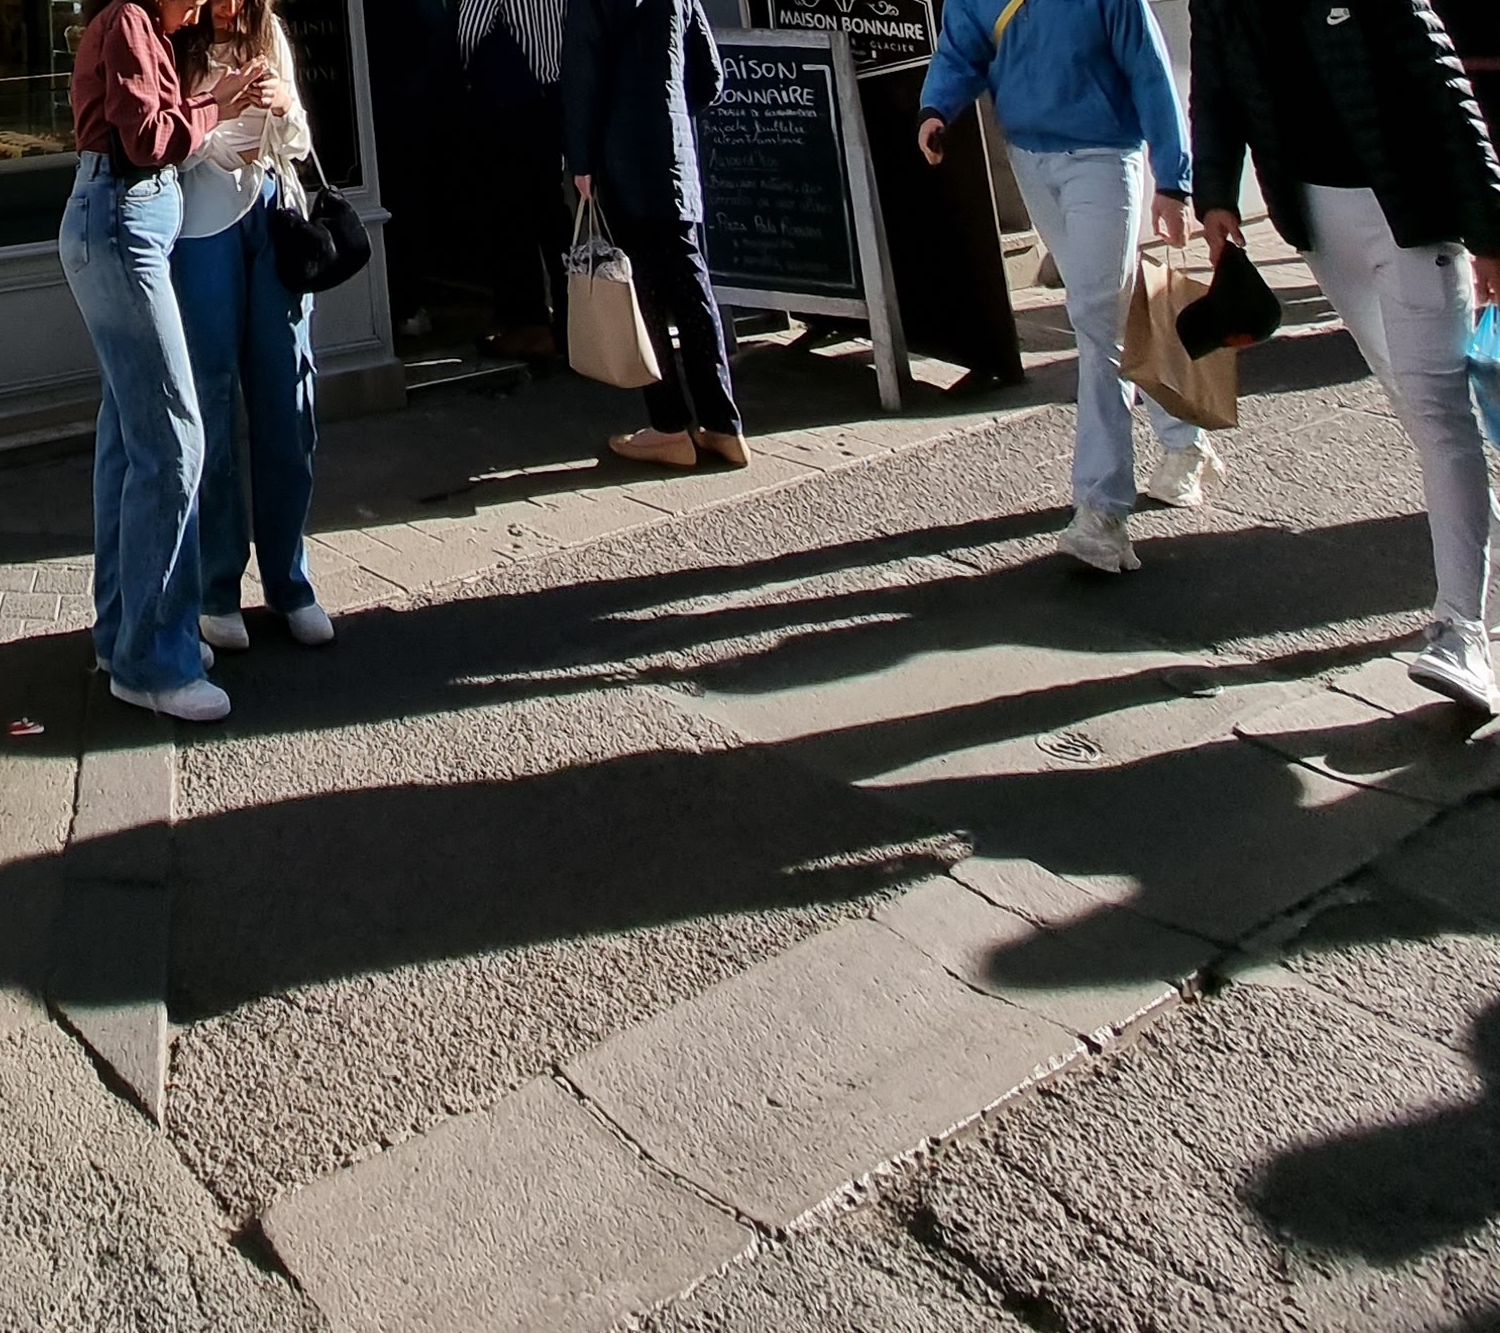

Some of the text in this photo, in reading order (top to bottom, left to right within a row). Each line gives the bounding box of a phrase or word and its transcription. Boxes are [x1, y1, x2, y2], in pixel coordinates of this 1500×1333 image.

[780, 9, 925, 41] MAISON BONNAIRE
[870, 38, 915, 53] GLACIER
